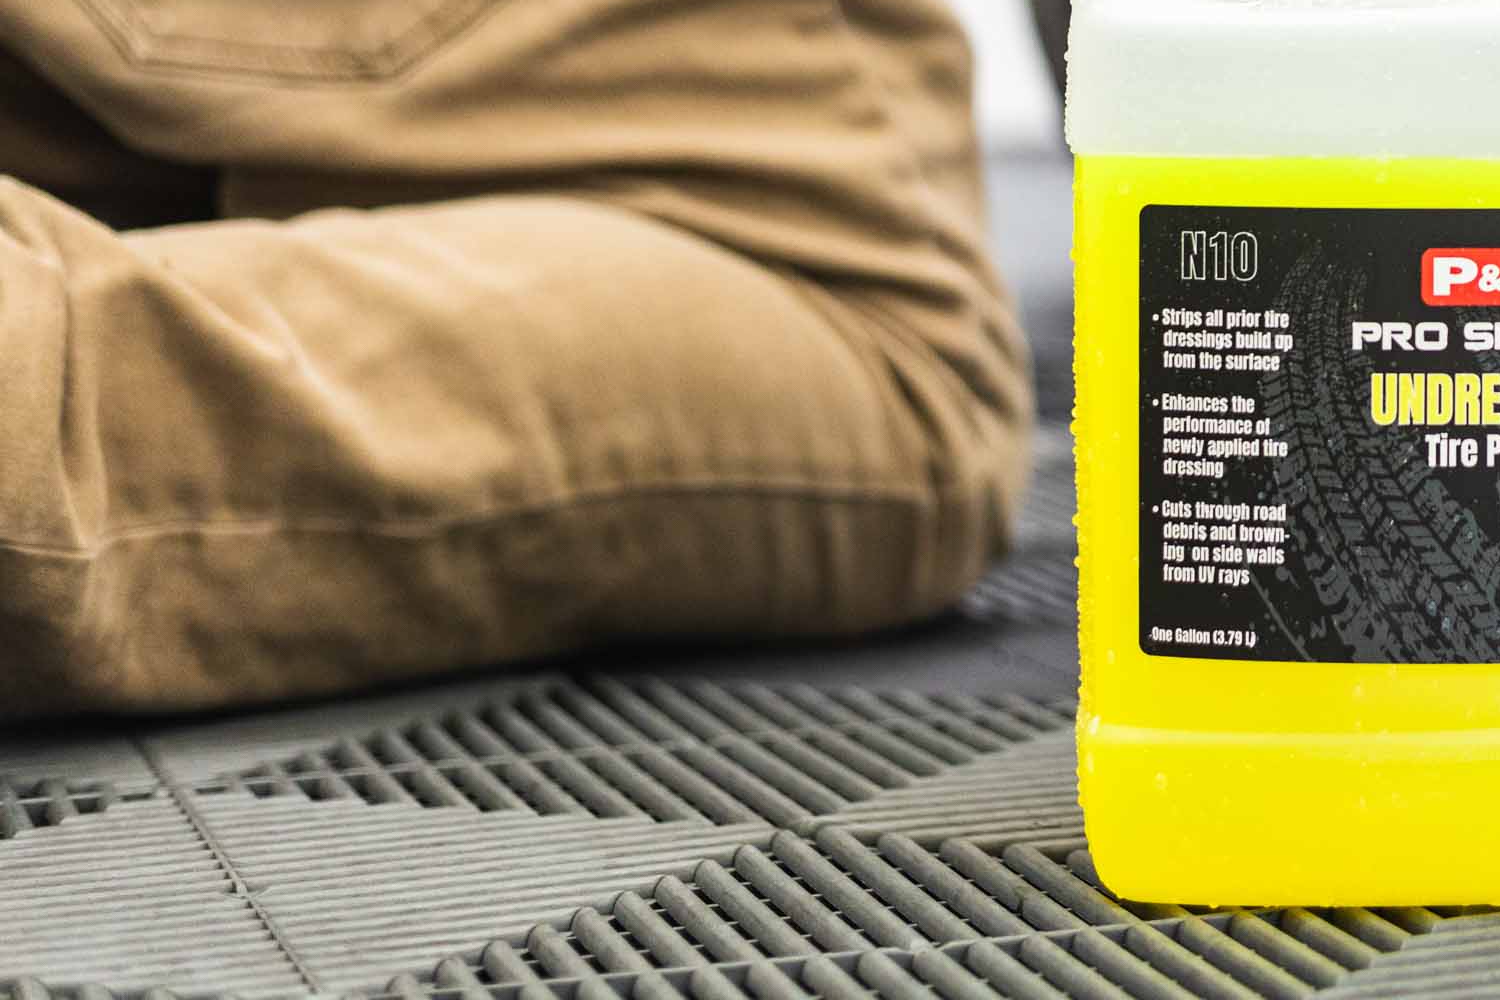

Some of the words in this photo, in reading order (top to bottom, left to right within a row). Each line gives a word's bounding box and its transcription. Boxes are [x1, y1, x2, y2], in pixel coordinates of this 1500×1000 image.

[1181, 231, 1257, 281] N10
[1162, 308, 1202, 328] Strips
[1206, 310, 1223, 327] all
[1226, 310, 1261, 329] prior
[1264, 310, 1289, 328] tire
[1163, 330, 1232, 350] dressings
[1236, 332, 1271, 349] build
[1274, 334, 1293, 352] up
[1352, 322, 1448, 351] PRO
[1163, 351, 1195, 368] from
[1199, 352, 1222, 370] the
[1225, 353, 1280, 371] surface
[1162, 393, 1228, 412] Enhances
[1232, 395, 1255, 413] the
[1163, 416, 1252, 435] performance
[1256, 417, 1270, 435] of
[1163, 437, 1204, 456] newly
[1207, 438, 1260, 458] applied
[1263, 439, 1288, 457] tire
[1425, 433, 1478, 468] Tire
[1163, 458, 1224, 479] dressing
[1162, 500, 1192, 518] Cuts
[1195, 502, 1249, 522] through
[1253, 503, 1286, 521] road
[1163, 522, 1207, 541] debris
[1210, 524, 1236, 542] and
[1239, 525, 1290, 543] brown-
[1163, 542, 1184, 561] ing
[1192, 546, 1209, 561] on
[1213, 545, 1243, 563] side
[1247, 546, 1285, 564] walls
[1163, 564, 1195, 582] from
[1198, 566, 1215, 583] UV
[1218, 568, 1250, 586] rays
[1152, 627, 1172, 641] One
[1176, 628, 1210, 644] Gallon
[1213, 630, 1243, 645] (3.79
